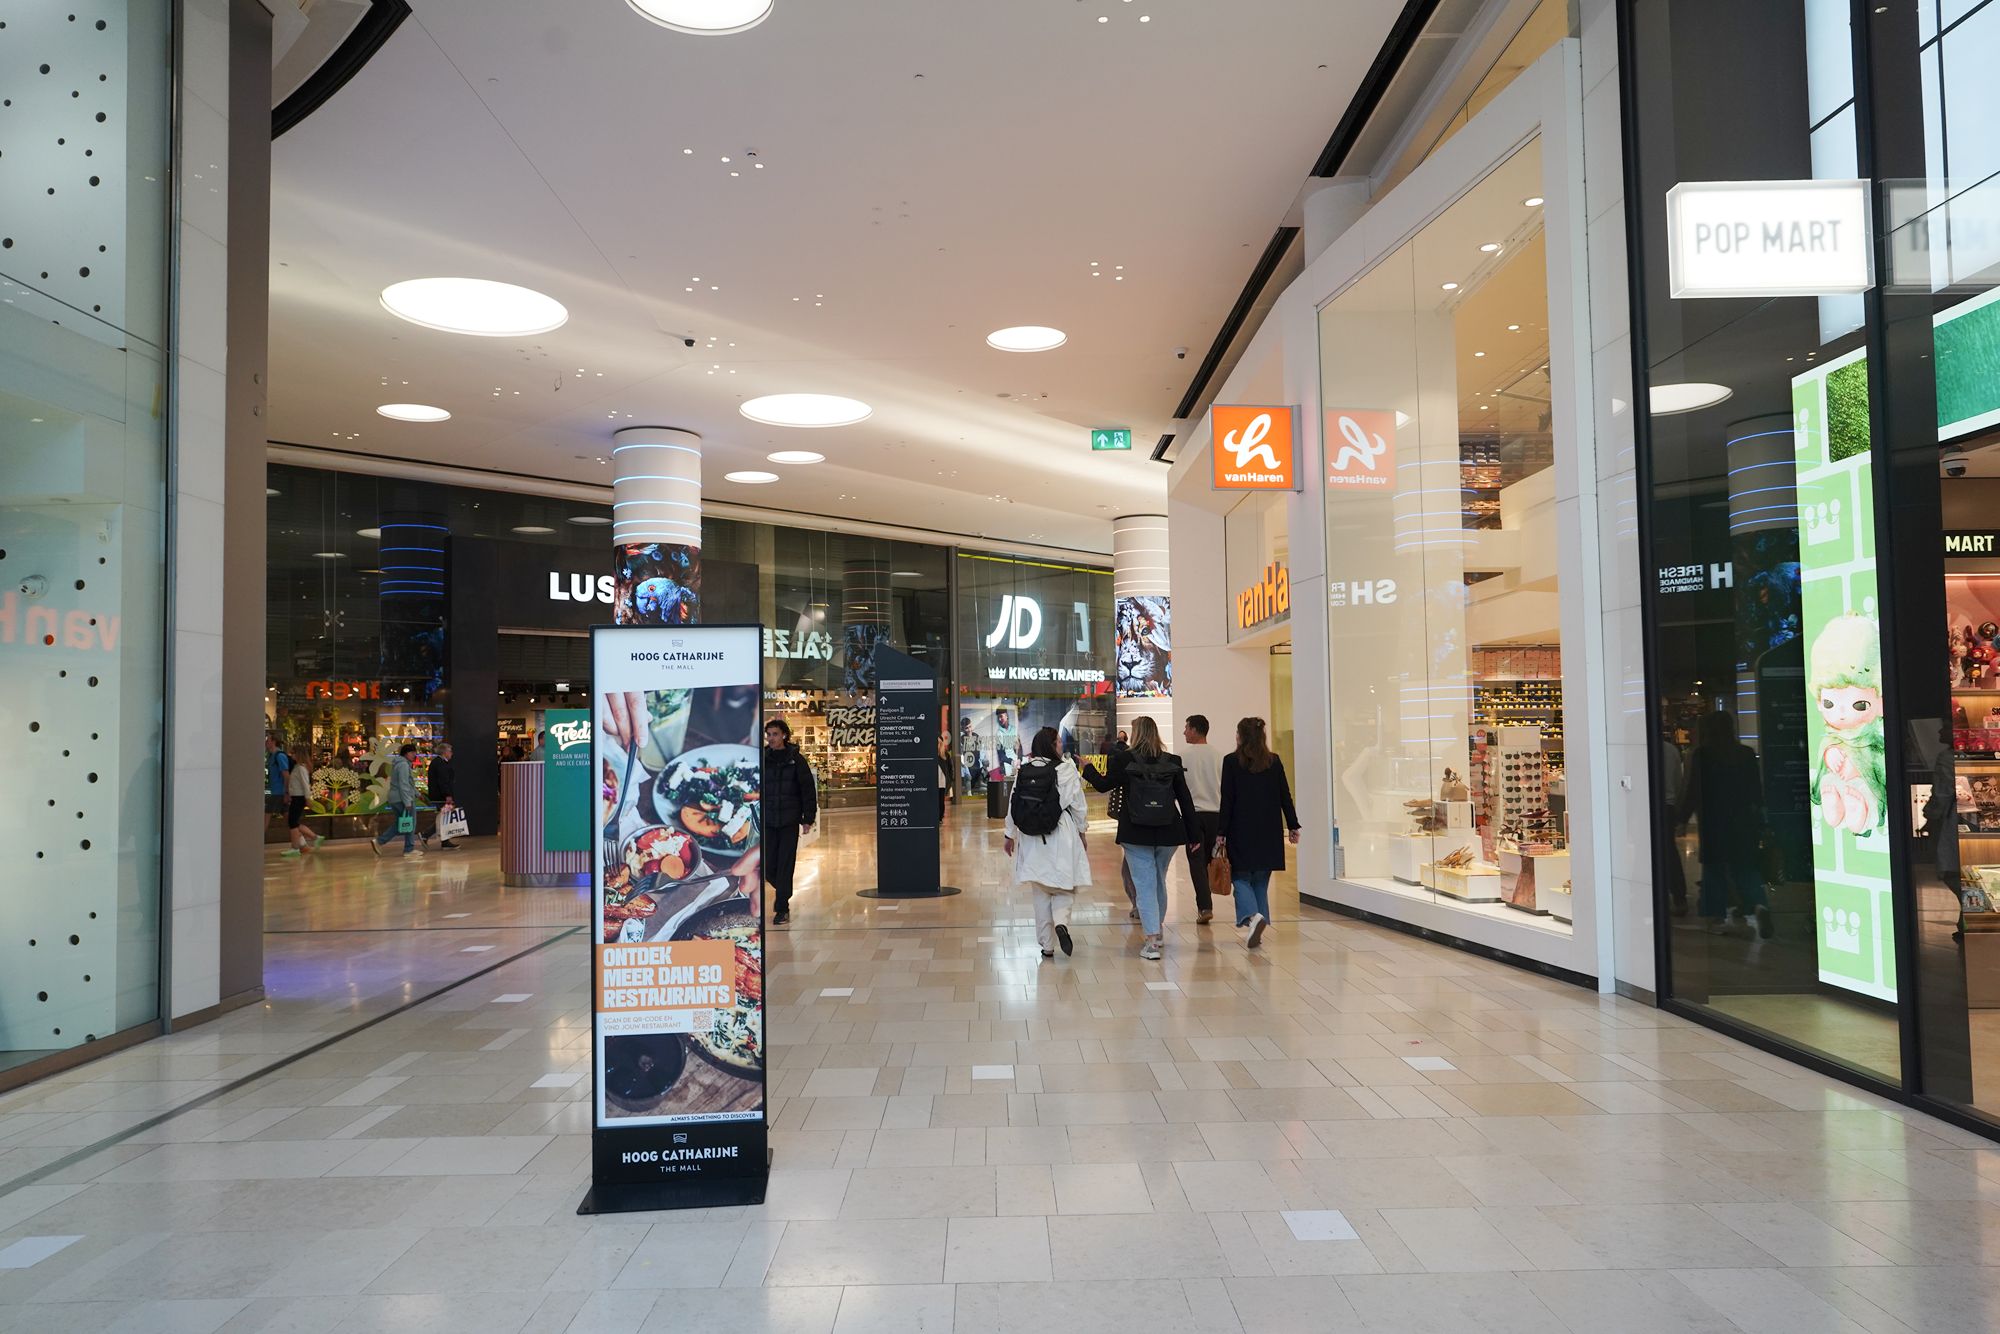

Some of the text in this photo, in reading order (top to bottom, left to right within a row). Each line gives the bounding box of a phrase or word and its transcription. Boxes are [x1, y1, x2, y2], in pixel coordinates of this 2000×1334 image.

[1695, 219, 1842, 254] POP MART
[1225, 472, 1284, 483] vanHaren
[1945, 535, 1994, 552] MART
[985, 594, 1042, 649] JD
[631, 651, 724, 661] HOOG CATHARIJNE
[1009, 666, 1105, 682] KING OF TRAINERS
[828, 706, 876, 726] FRESH
[830, 726, 876, 745] PICKE
[603, 946, 672, 967] ONTDEK
[603, 964, 722, 987] MEER DAN 30
[603, 985, 730, 1008] RESTAURANTS
[622, 1146, 739, 1163] HOOG CATHARIJNE
[660, 1165, 677, 1173] THE
